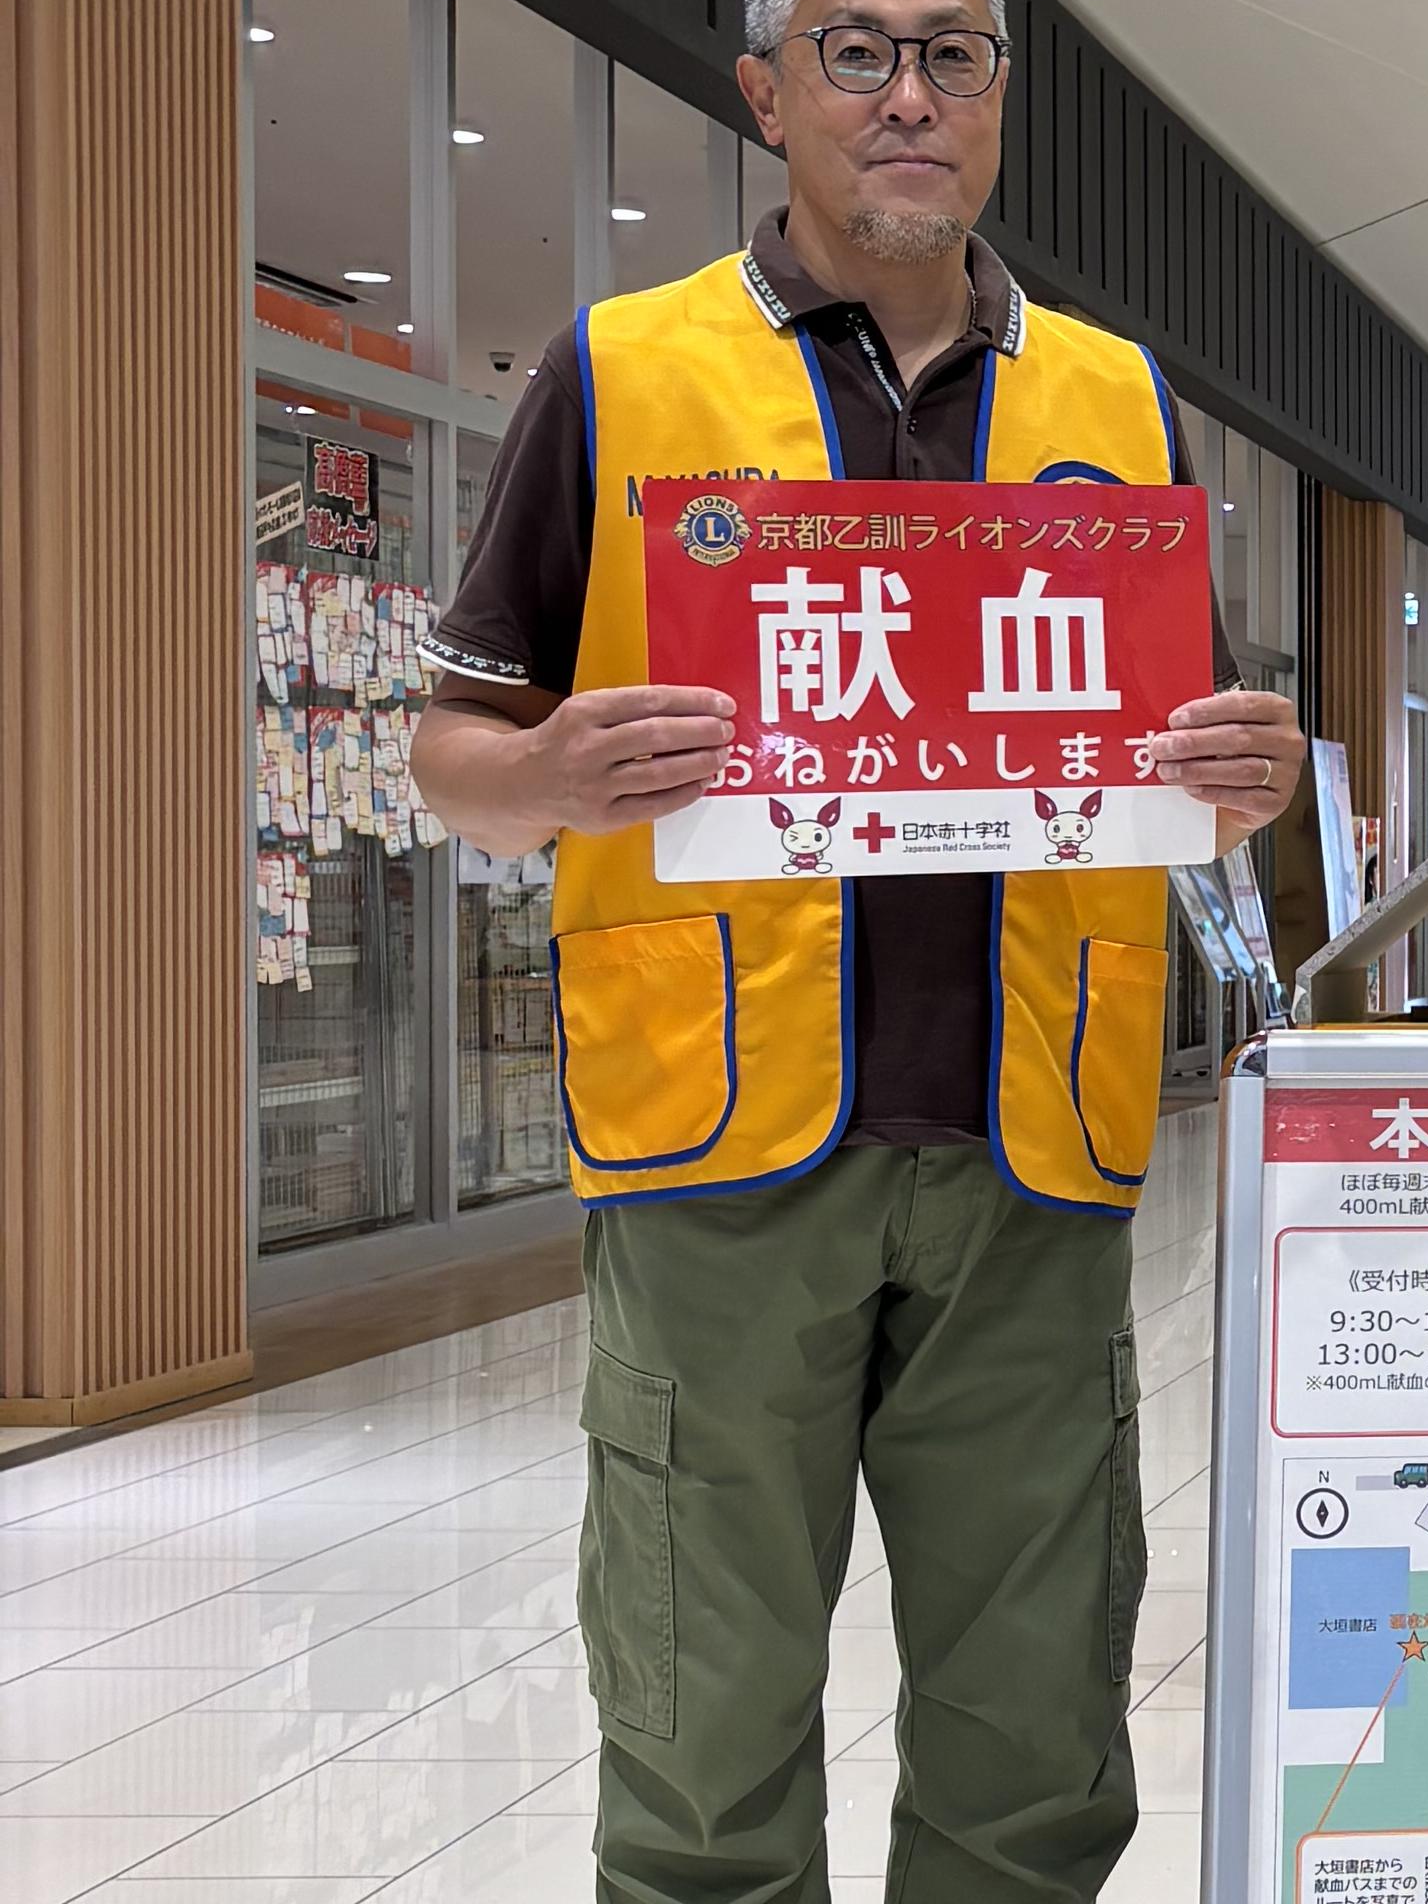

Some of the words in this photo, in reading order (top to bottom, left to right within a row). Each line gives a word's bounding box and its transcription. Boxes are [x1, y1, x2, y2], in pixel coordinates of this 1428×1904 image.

[690, 497, 735, 514] LIONS
[704, 516, 725, 542] L
[755, 511, 1190, 553] 京都乙訓ライオンズクラブ
[750, 565, 1122, 725] 献血
[902, 821, 1011, 841] 日本赤十字社
[942, 843, 958, 852] Red
[982, 842, 1011, 851] Society
[1318, 1469, 1330, 1484] N
[1318, 1618, 1378, 1633] 大垣書店
[1314, 1858, 1403, 1875] 大垣書店から
[1314, 1876, 1418, 1893] 献血バスまでの
